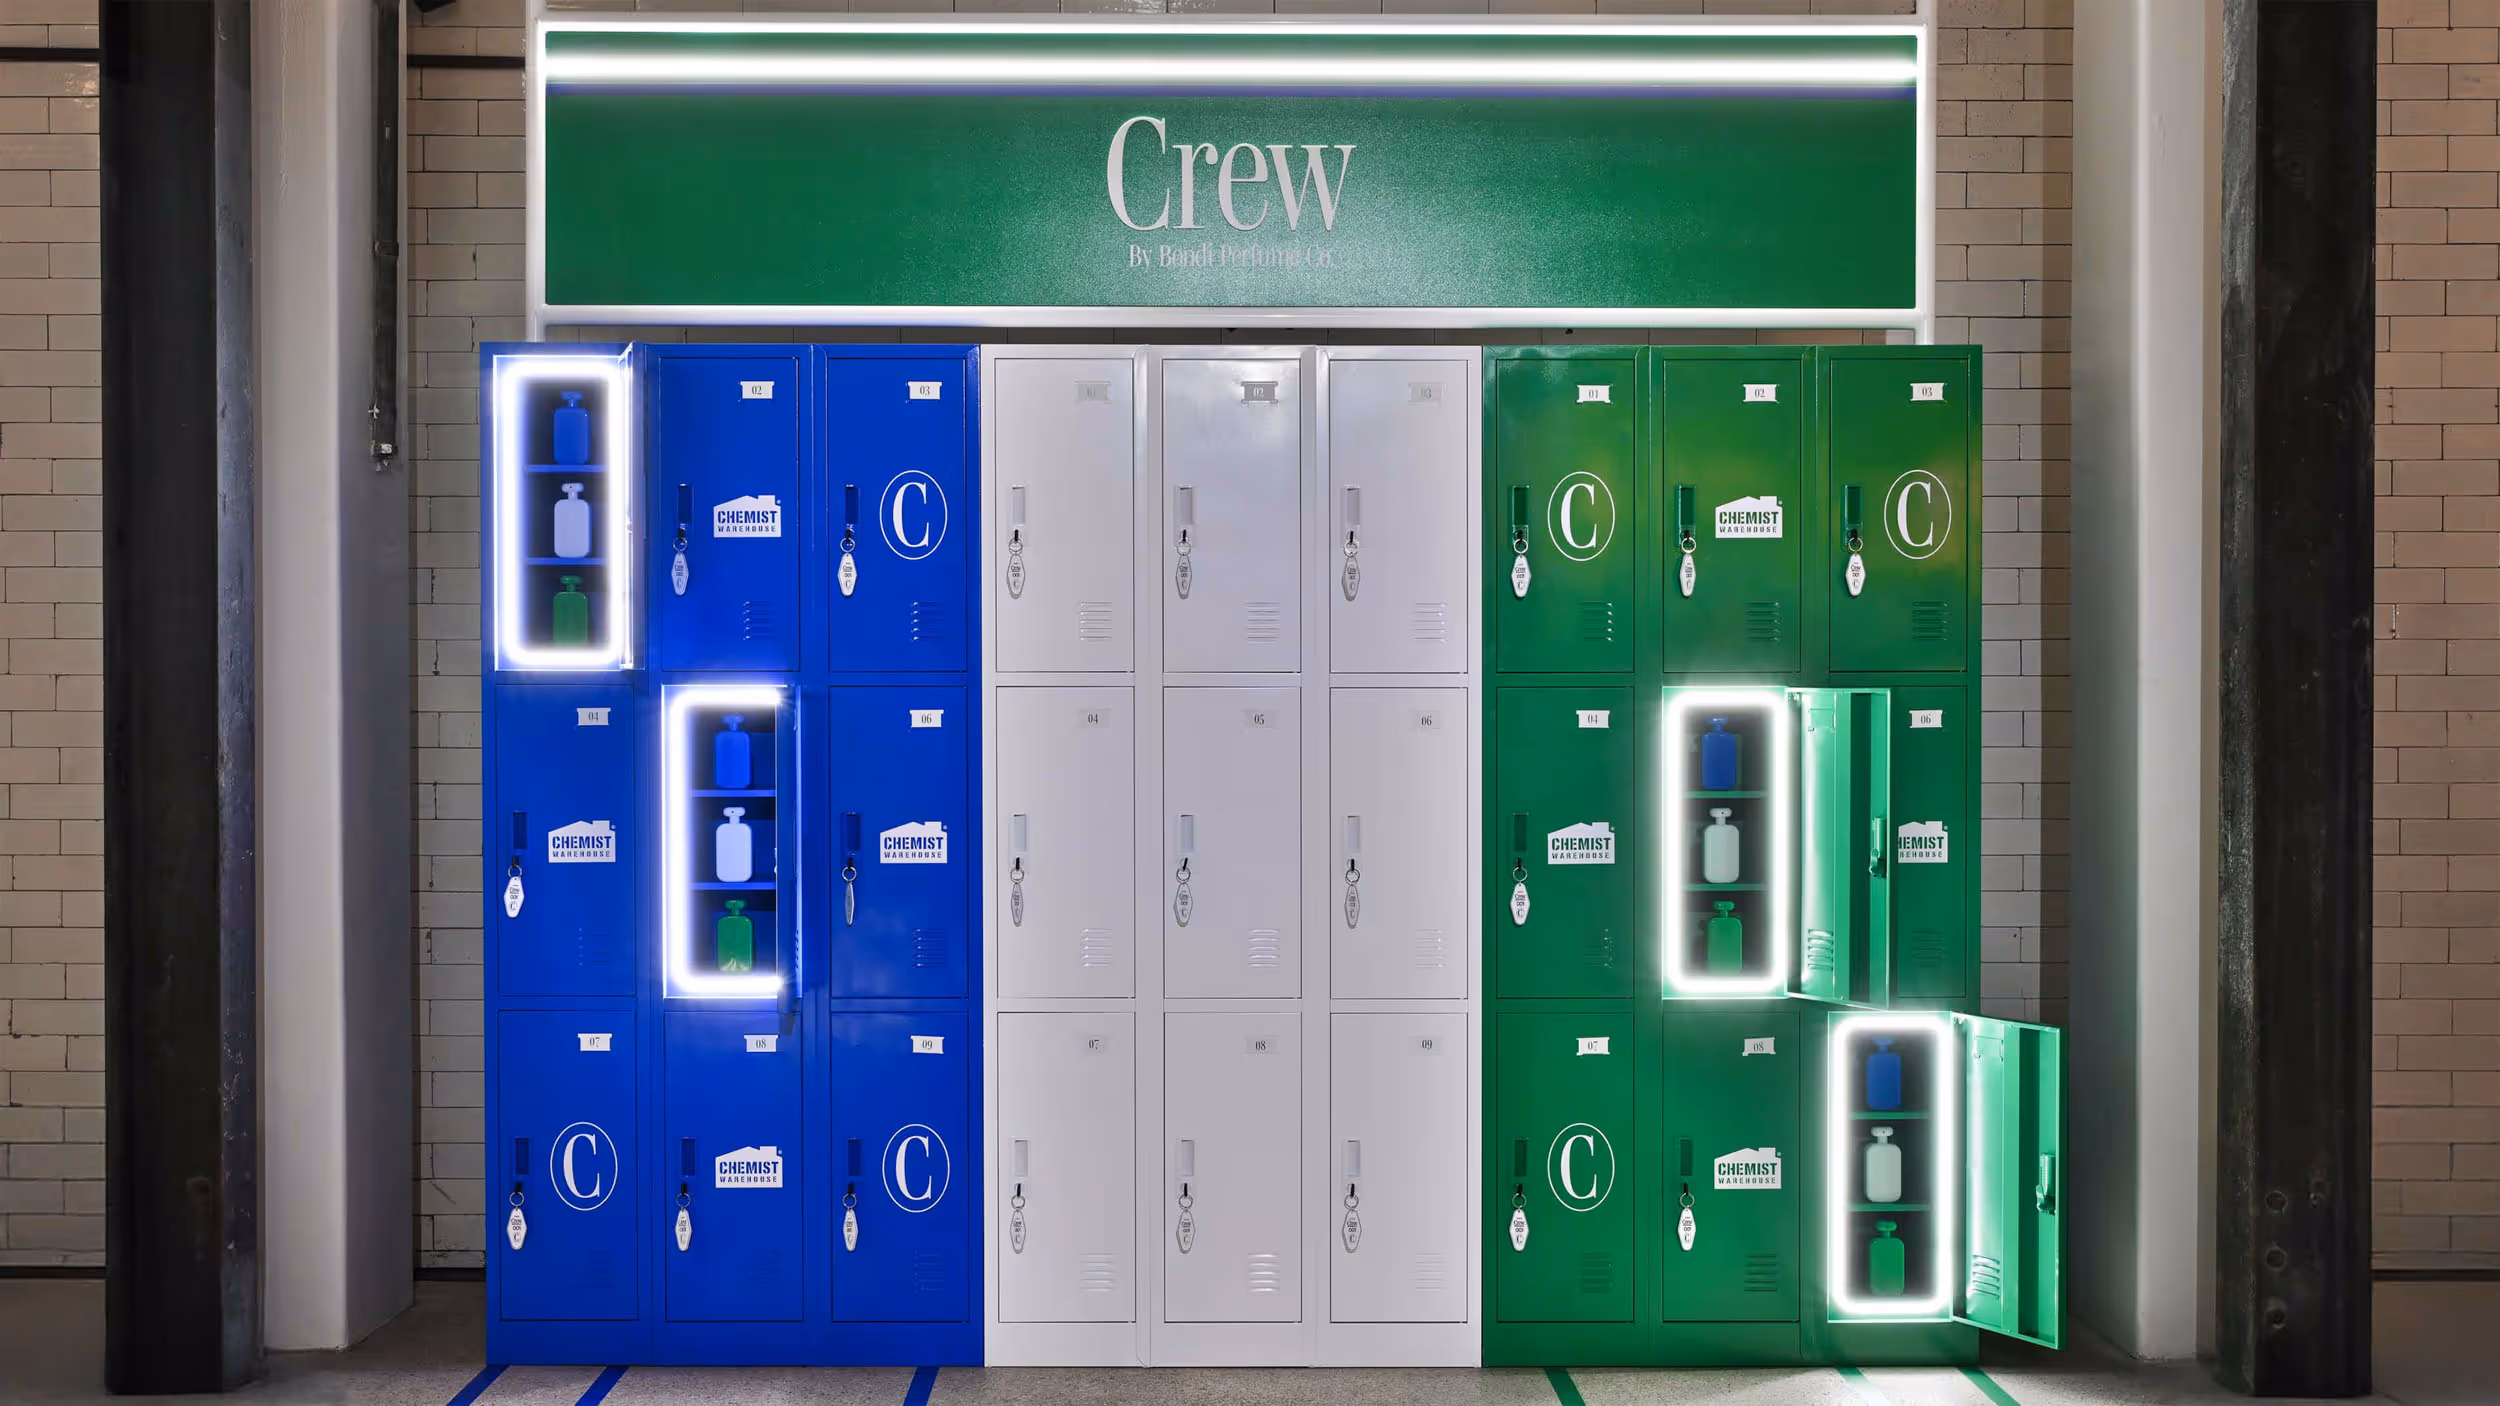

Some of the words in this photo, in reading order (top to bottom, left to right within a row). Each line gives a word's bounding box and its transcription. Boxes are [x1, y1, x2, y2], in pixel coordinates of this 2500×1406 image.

[1106, 115, 1357, 232] Crew
[1129, 243, 1153, 271] By
[1159, 242, 1214, 268] Bondi
[751, 385, 763, 396] 02
[919, 385, 931, 396] 03
[1253, 387, 1265, 397] 02
[1588, 389, 1599, 399] 01
[1754, 388, 1766, 398] 02
[1921, 386, 1933, 397] 03
[717, 510, 778, 524] CHEMIST
[892, 482, 930, 548] C
[1560, 483, 1598, 549] C
[1719, 511, 1779, 525] CHEMIST
[1896, 481, 1934, 547] C
[717, 525, 776, 533] WAREHOUSE
[1719, 525, 1777, 533] WAREHOUSE
[588, 711, 599, 721] 04
[921, 713, 933, 724] 06
[1087, 713, 1099, 725] 04
[1253, 713, 1265, 725] 05
[1421, 715, 1432, 726] 06
[1587, 714, 1598, 725] 04
[1920, 713, 1932, 724] 06
[552, 835, 612, 849] CHEMIST
[883, 836, 944, 850] CHEMIST
[1551, 837, 1611, 851] CHEMIST
[552, 850, 610, 858] WAREHOUSE
[883, 851, 942, 859] WAREHOUSE
[1551, 852, 1610, 860] WAREHOUSE
[1899, 850, 1943, 859] REHOUSE
[589, 1036, 601, 1048] 07
[755, 1038, 767, 1049] 08
[921, 1039, 933, 1050] 09
[1088, 1039, 1100, 1050] 07
[1255, 1040, 1266, 1051] 08
[1421, 1039, 1433, 1050] 09
[1587, 1040, 1599, 1052] 07
[1753, 1043, 1765, 1053] 08
[562, 1133, 600, 1199] C
[719, 1161, 779, 1175] CHEMIST
[894, 1135, 932, 1201] C
[1560, 1134, 1598, 1200] C
[1718, 1162, 1778, 1176] CHEMIST
[719, 1175, 777, 1183] WAREHOUSE
[1718, 1176, 1776, 1185] WAREHOUSE
